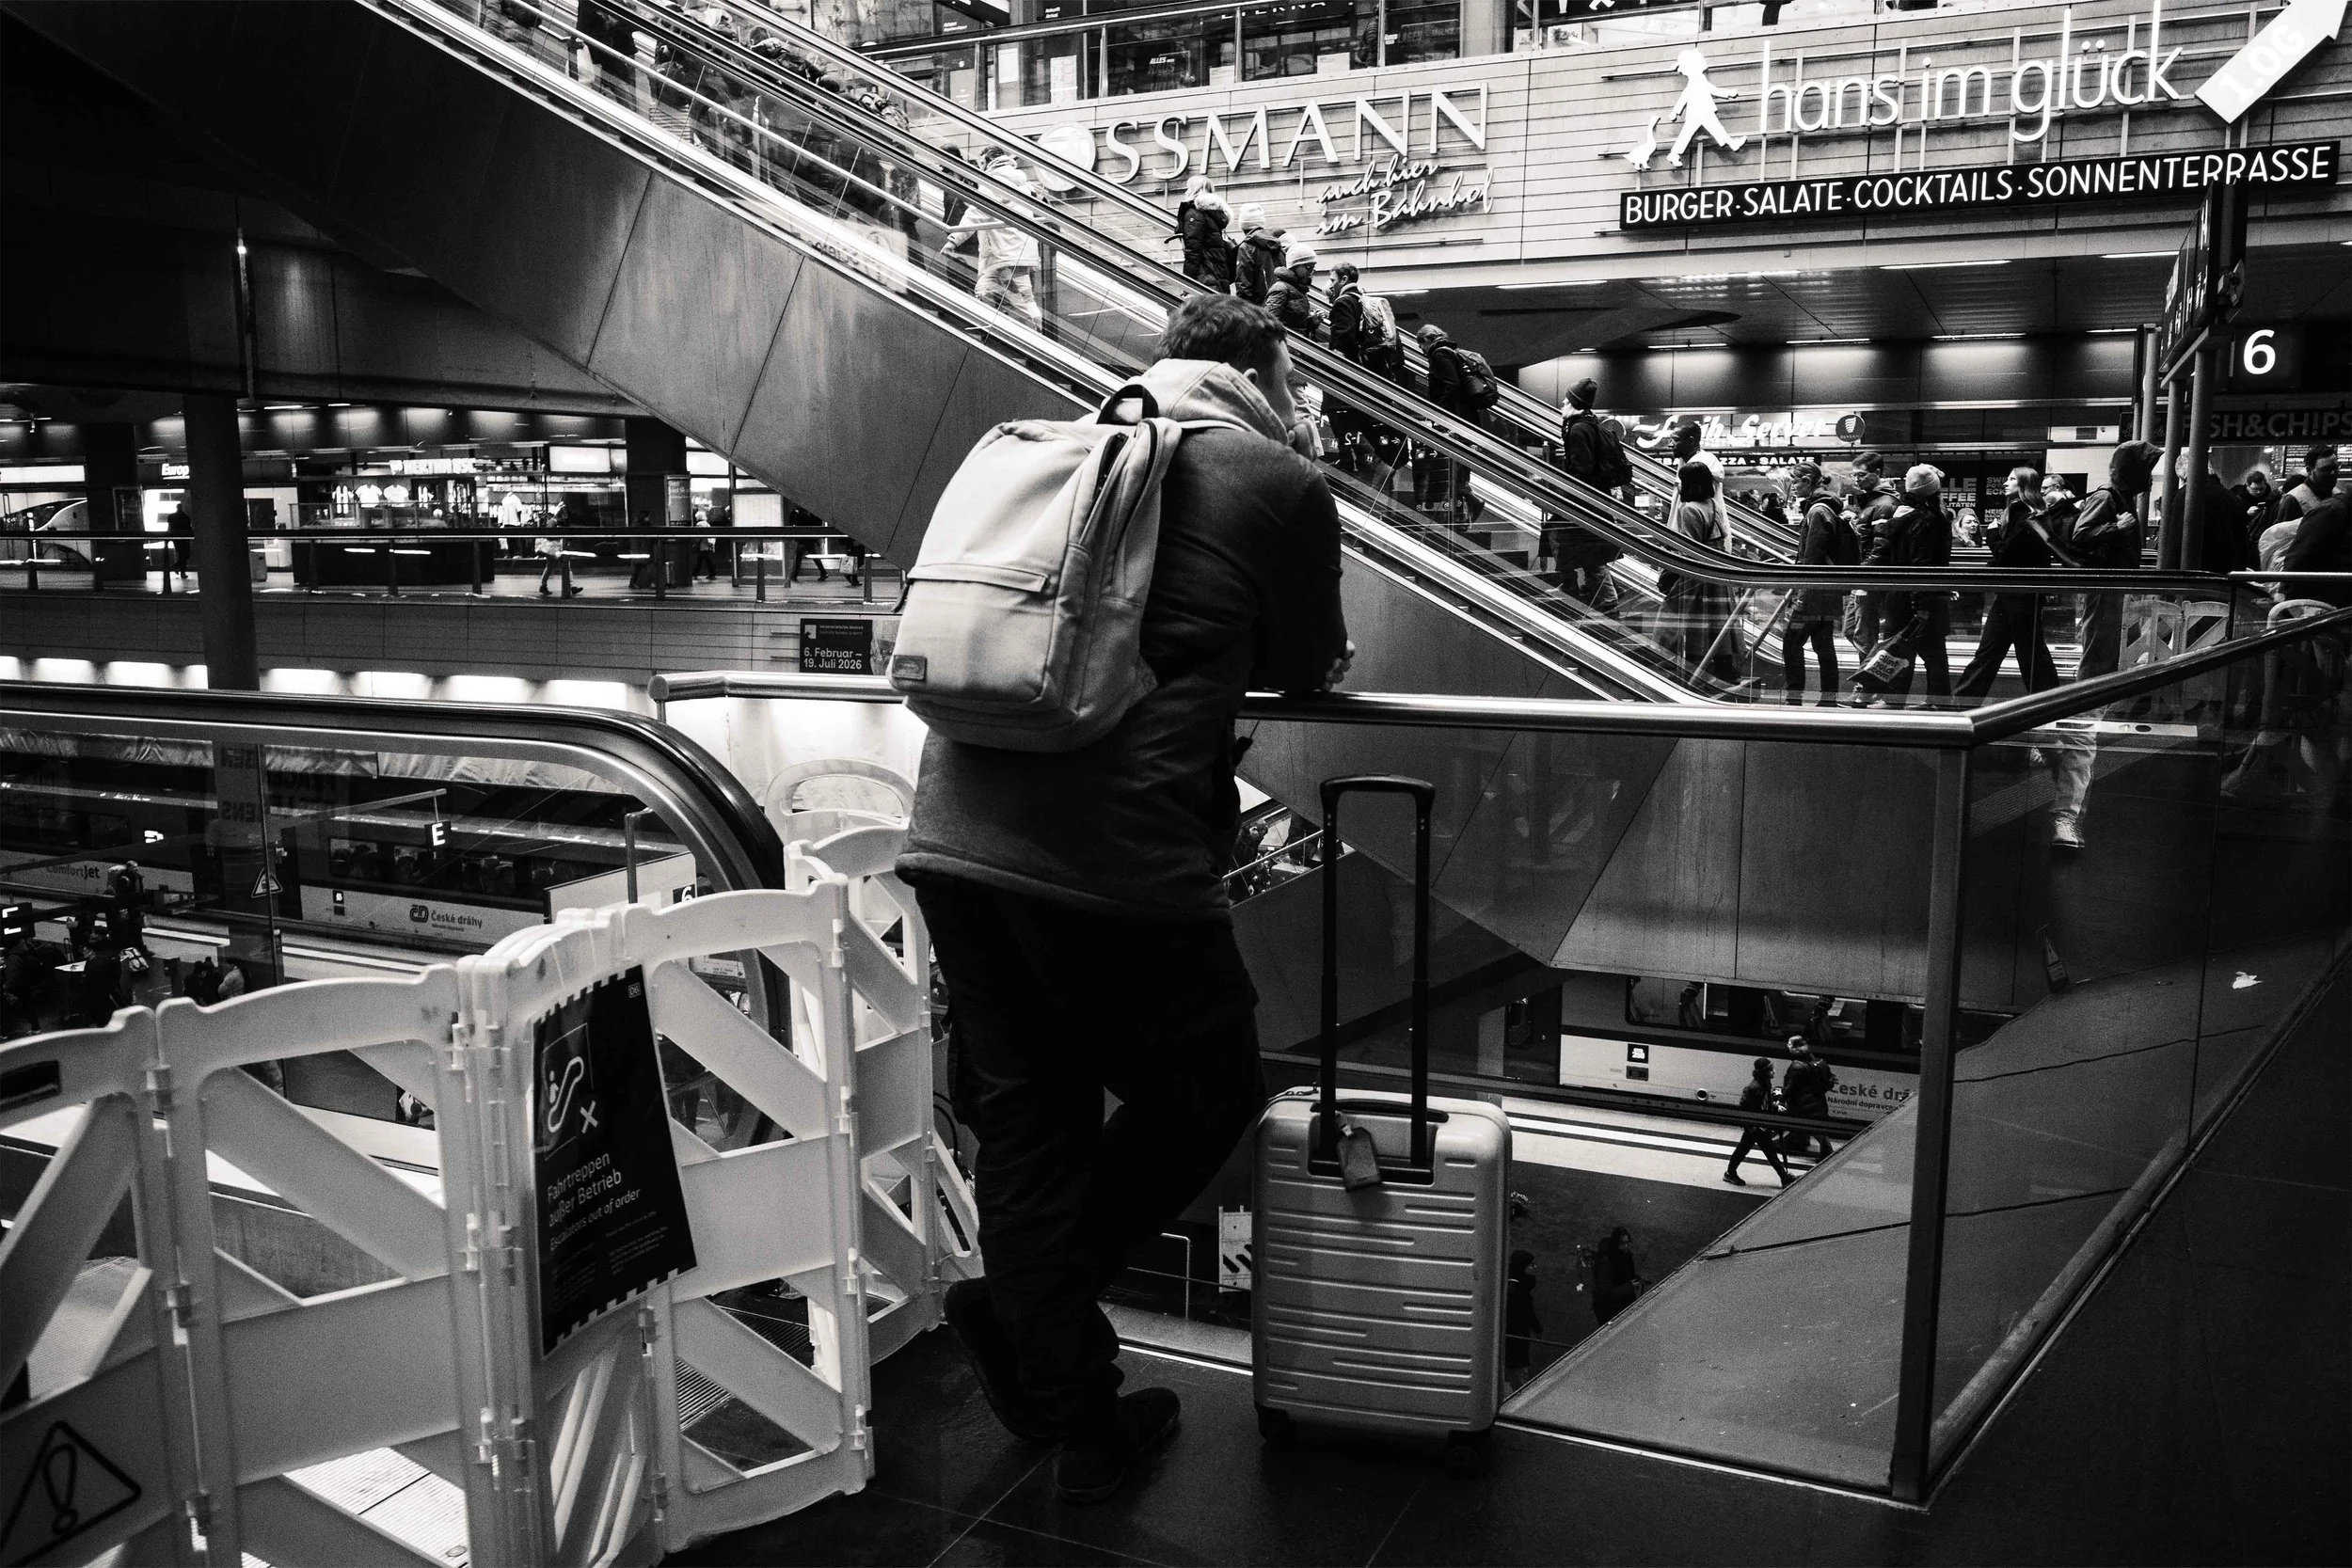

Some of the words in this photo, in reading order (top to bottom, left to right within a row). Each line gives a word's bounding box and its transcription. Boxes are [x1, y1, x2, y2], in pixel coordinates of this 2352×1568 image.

[1759, 40, 1899, 135] hans
[1921, 55, 1993, 121] im
[2011, 0, 2185, 144] glück
[1037, 82, 1488, 192] OSSMANN
[1370, 166, 1494, 229] Bahnhof
[1625, 188, 1733, 225] BURGER
[1742, 182, 1842, 217] SALATE
[1852, 170, 2013, 210] COCKTAILS
[2026, 146, 2330, 199] SONNENTERRASSE
[2243, 329, 2276, 375] 6
[815, 647, 853, 658] Februar
[818, 658, 835, 669] Juli
[838, 659, 862, 670] 2026
[432, 822, 445, 847] E
[547, 1152, 611, 1205] Fahrtreppen
[548, 1195, 576, 1227] außer
[578, 1169, 624, 1207] Betrieb
[587, 1207, 603, 1225] out
[603, 1197, 616, 1215] of
[614, 1188, 642, 1210] order
